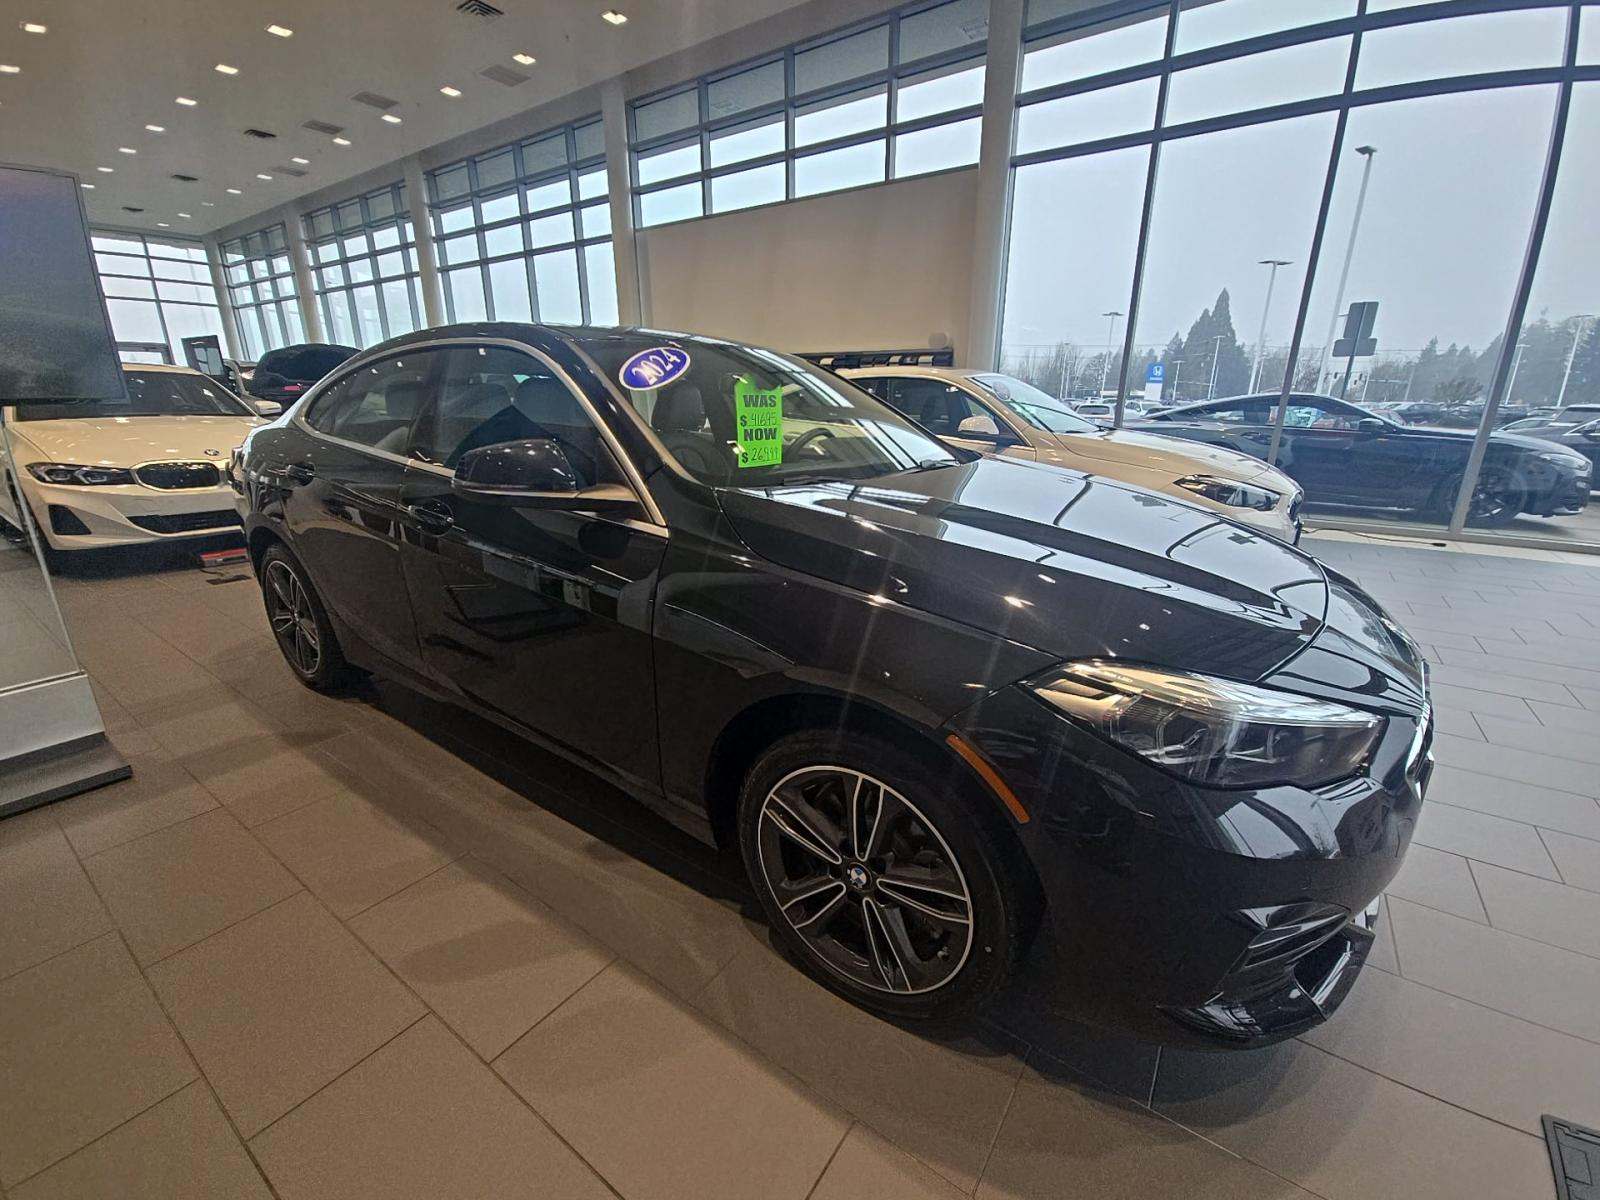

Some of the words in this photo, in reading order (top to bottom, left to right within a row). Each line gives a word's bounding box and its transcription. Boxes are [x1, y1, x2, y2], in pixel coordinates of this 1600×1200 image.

[631, 349, 680, 385] 2024
[743, 395, 776, 407] WAS
[743, 428, 777, 441] NOW
